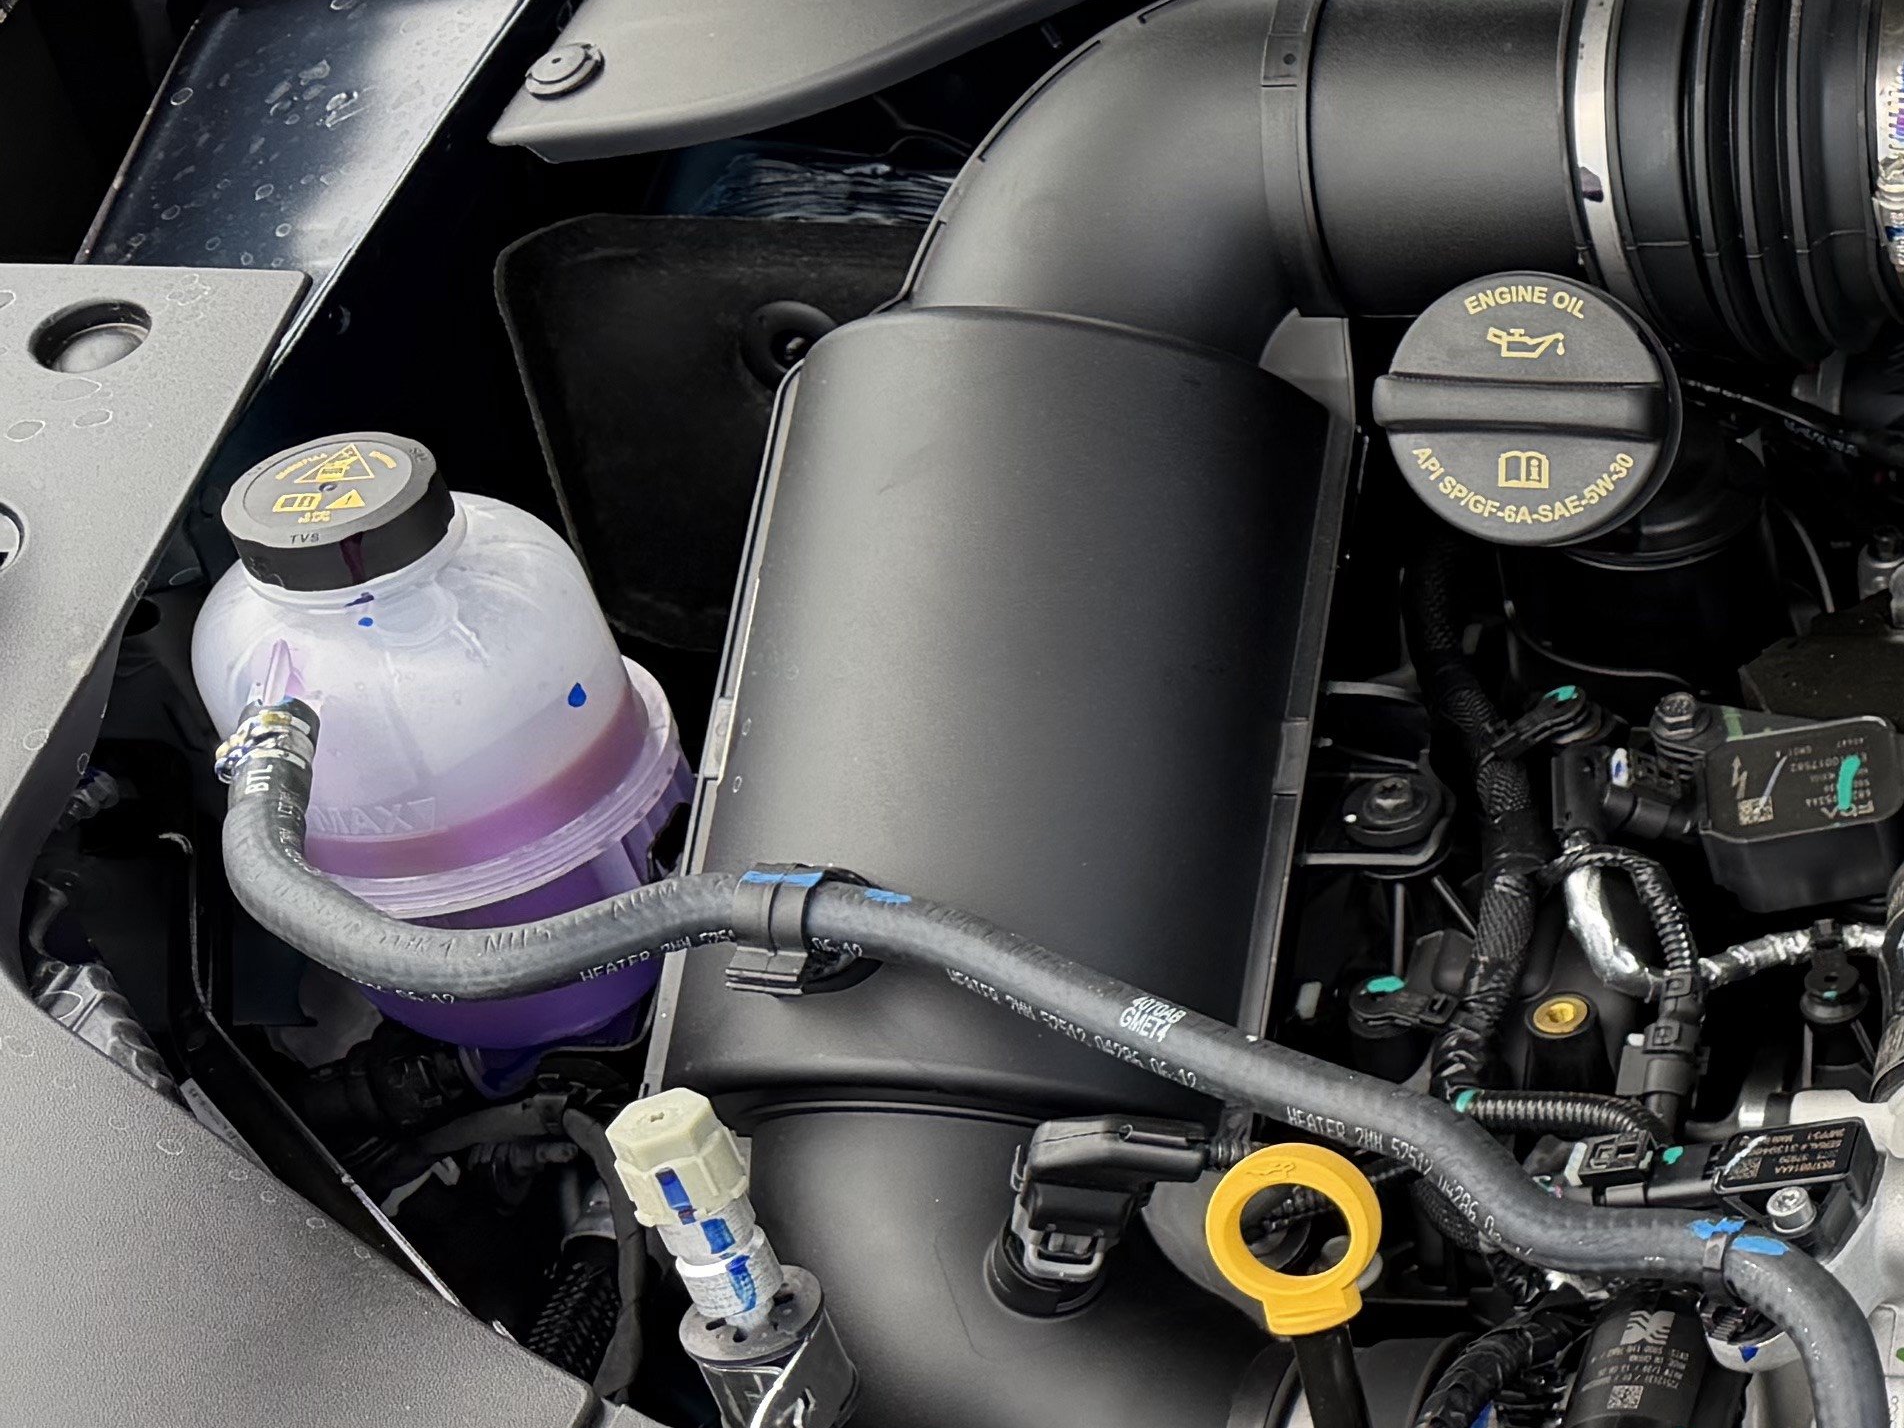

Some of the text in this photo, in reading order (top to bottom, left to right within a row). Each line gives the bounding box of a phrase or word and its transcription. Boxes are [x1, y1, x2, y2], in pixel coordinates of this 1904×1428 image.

[1463, 285, 1585, 319] ENGINE OIL
[1412, 447, 1635, 525] API SP/GF-6A-SAE-5W-30
[290, 532, 320, 544] TVS
[1120, 1006, 1172, 1042] GMET4
[1132, 996, 1187, 1024] 4070AB
[1286, 1106, 1346, 1139] HEATER
